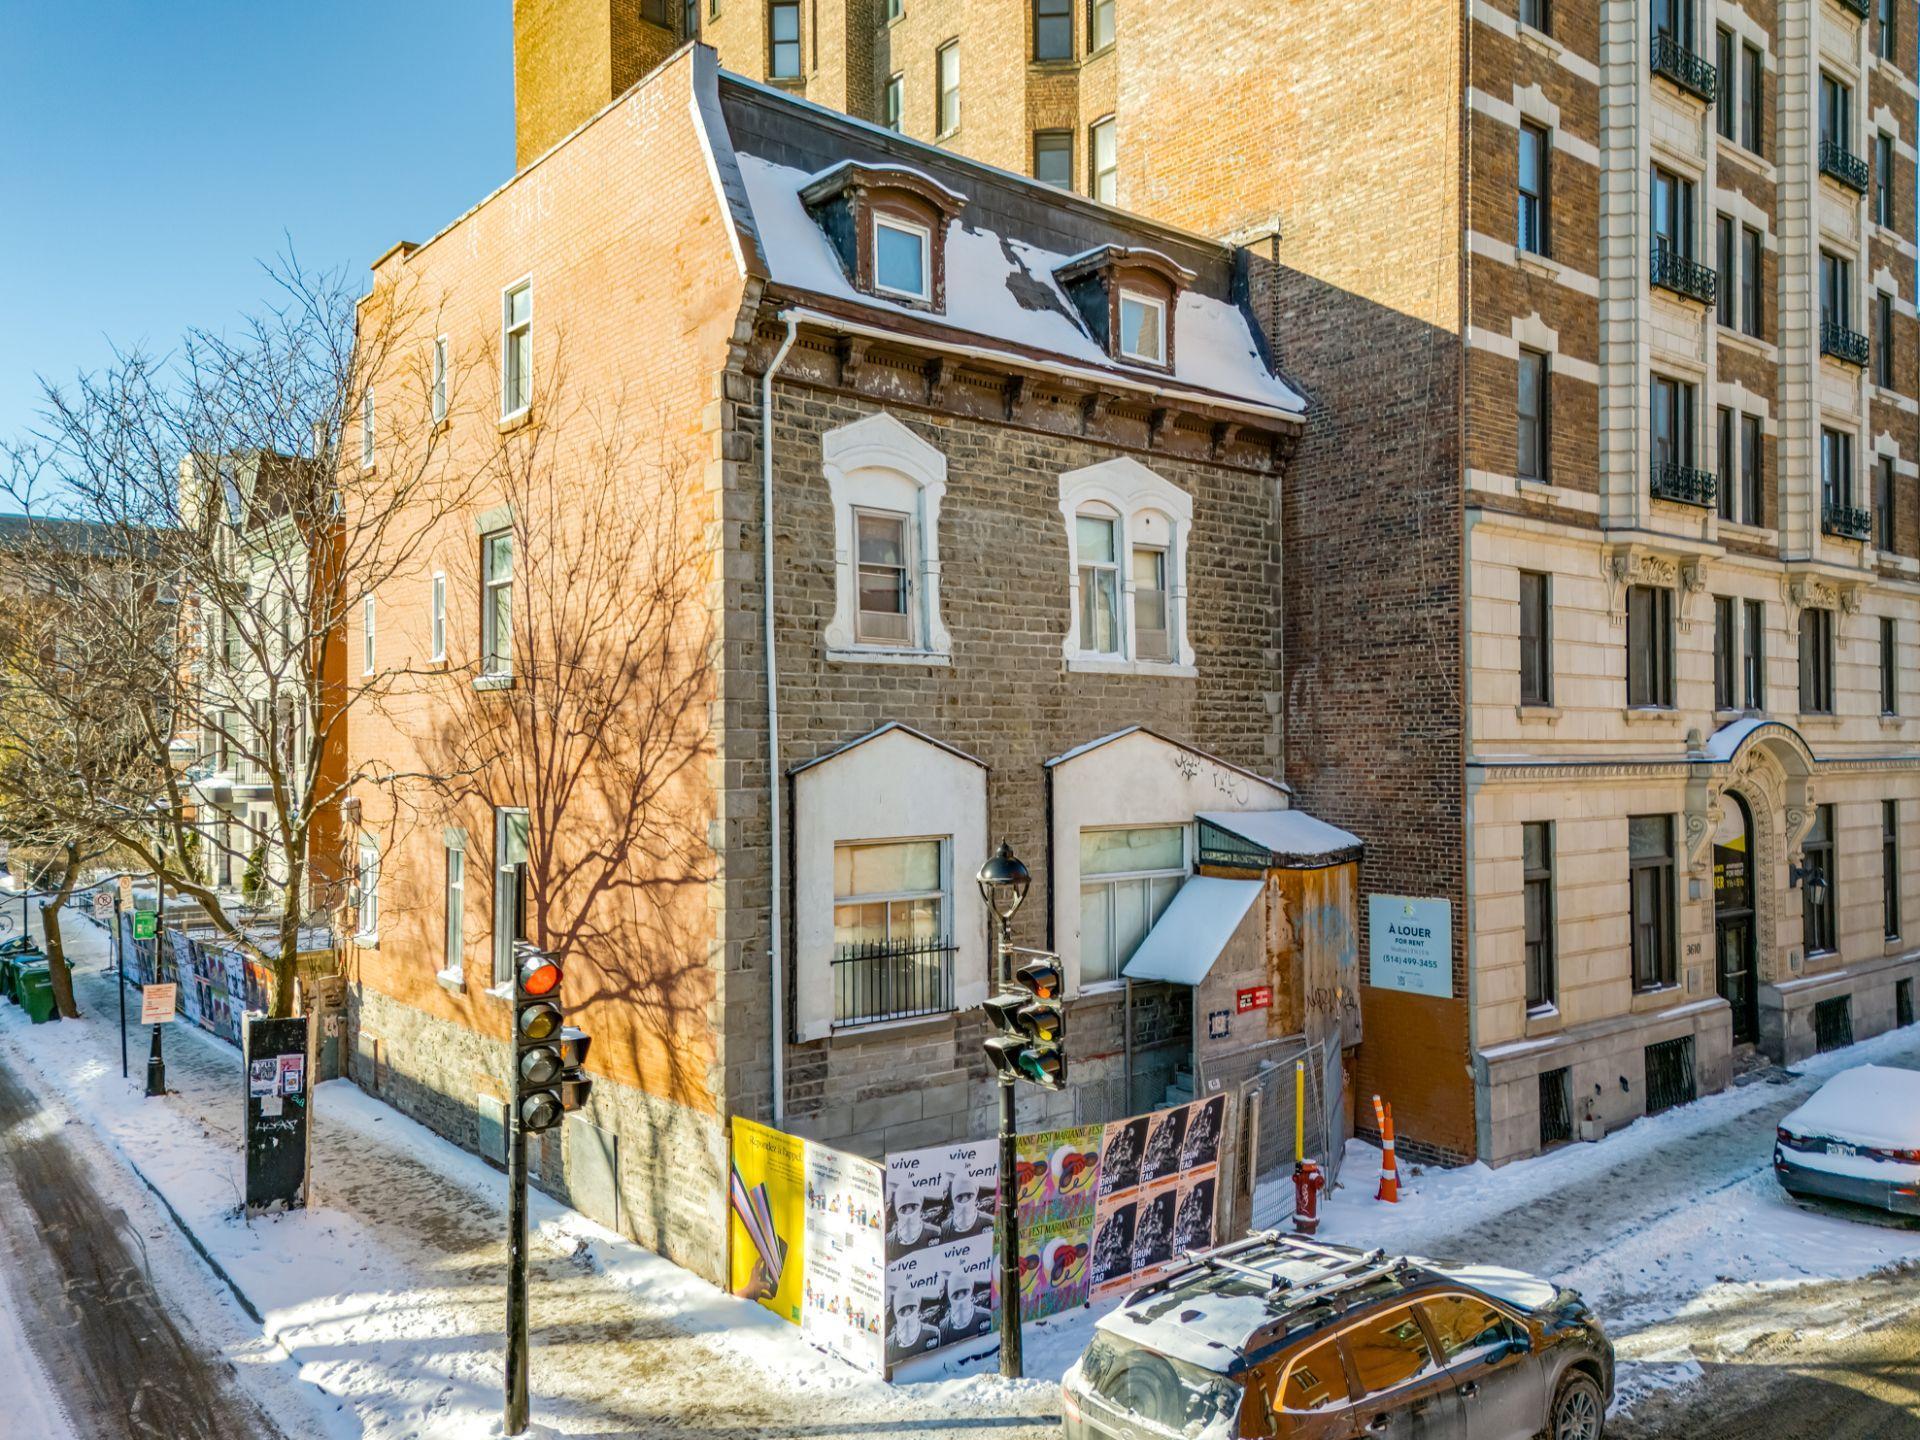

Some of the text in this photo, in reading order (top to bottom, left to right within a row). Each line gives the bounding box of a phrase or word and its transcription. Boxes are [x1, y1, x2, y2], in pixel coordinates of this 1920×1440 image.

[1389, 922, 1431, 938] À LOUER
[1408, 939, 1424, 947] RENT
[1383, 955, 1438, 969] (514) 499-3455
[1036, 1131, 1053, 1144] FEST
[1054, 1126, 1088, 1141] MARIANNE
[1088, 1123, 1104, 1135] FEST
[949, 1149, 977, 1161] vive
[1182, 1150, 1199, 1163] DRUM
[891, 1157, 920, 1170] vive
[968, 1163, 997, 1178] vent
[1141, 1161, 1160, 1175] DRUM
[1181, 1159, 1193, 1171] TAO
[908, 1171, 915, 1179] le
[911, 1172, 942, 1188] vent
[1100, 1173, 1120, 1188] DRUM
[1140, 1171, 1154, 1184] TAO
[1099, 1183, 1113, 1196] TAO
[1028, 1225, 1043, 1237] FEST
[1044, 1218, 1078, 1234] MARIANNE
[1078, 1214, 1093, 1227] FEST
[1174, 1234, 1192, 1247] DRUM
[944, 1245, 971, 1259] vive
[1133, 1246, 1152, 1261] DRUM
[963, 1256, 991, 1273] vent
[1091, 1263, 1111, 1277] DRUM
[1132, 1257, 1146, 1269] TAO
[905, 1272, 913, 1280] le
[909, 1271, 939, 1289] vent
[1091, 1272, 1105, 1285] TAO
